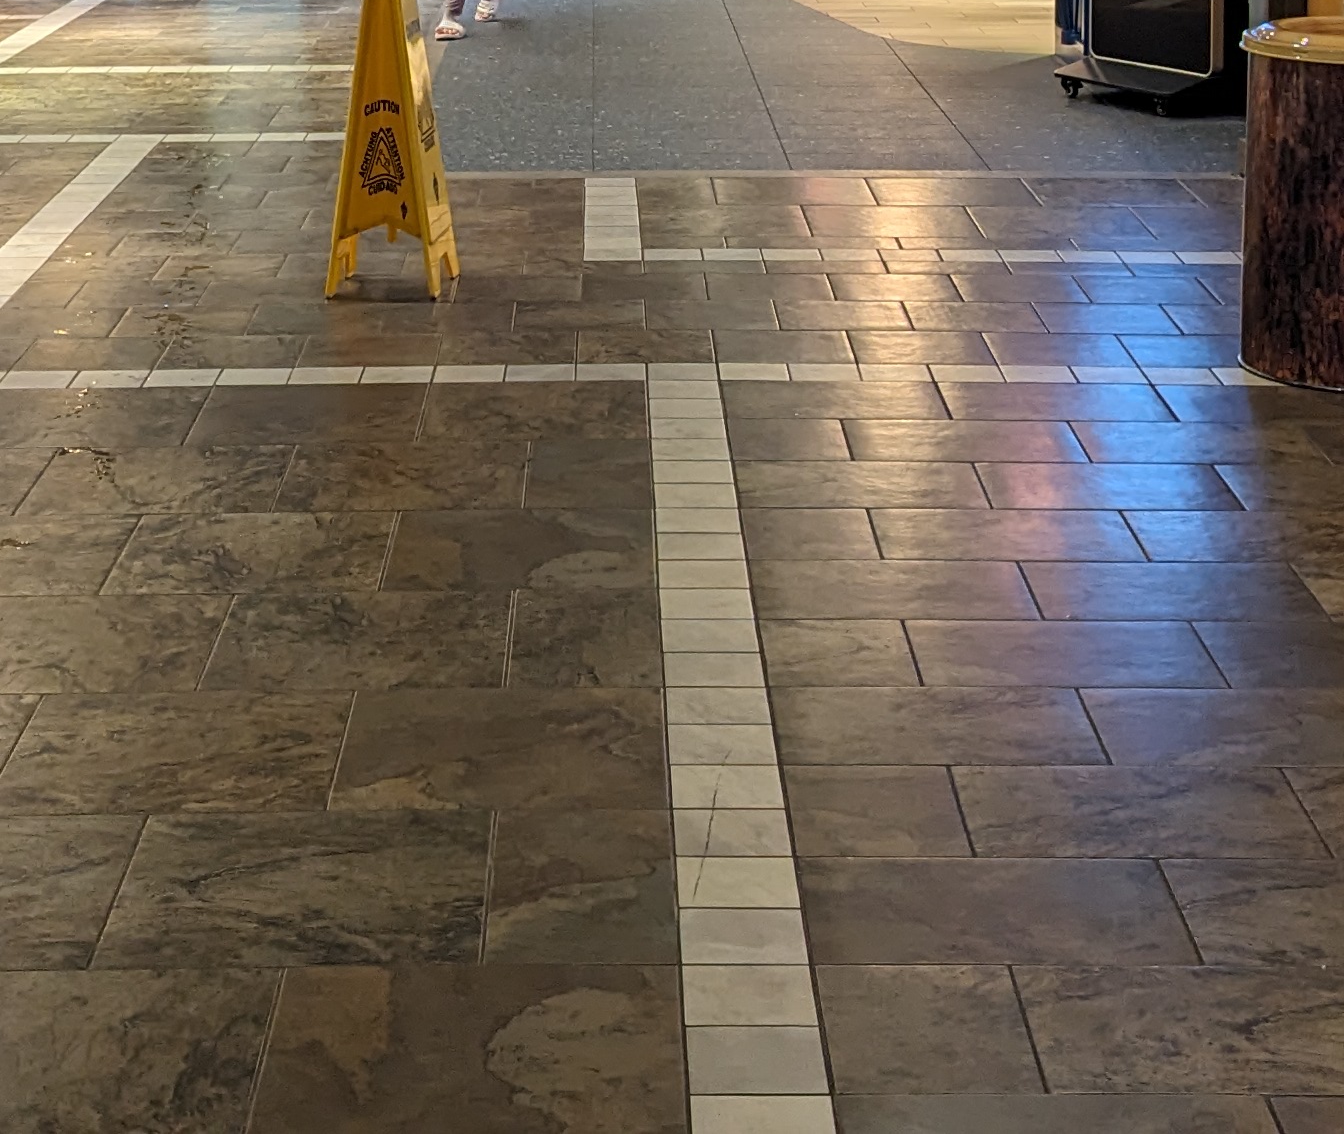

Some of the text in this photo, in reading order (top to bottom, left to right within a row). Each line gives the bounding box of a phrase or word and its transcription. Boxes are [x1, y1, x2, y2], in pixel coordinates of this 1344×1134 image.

[364, 99, 400, 116] CAUTION
[359, 131, 378, 178] ACHTUNG
[385, 127, 406, 180] ATTENTION
